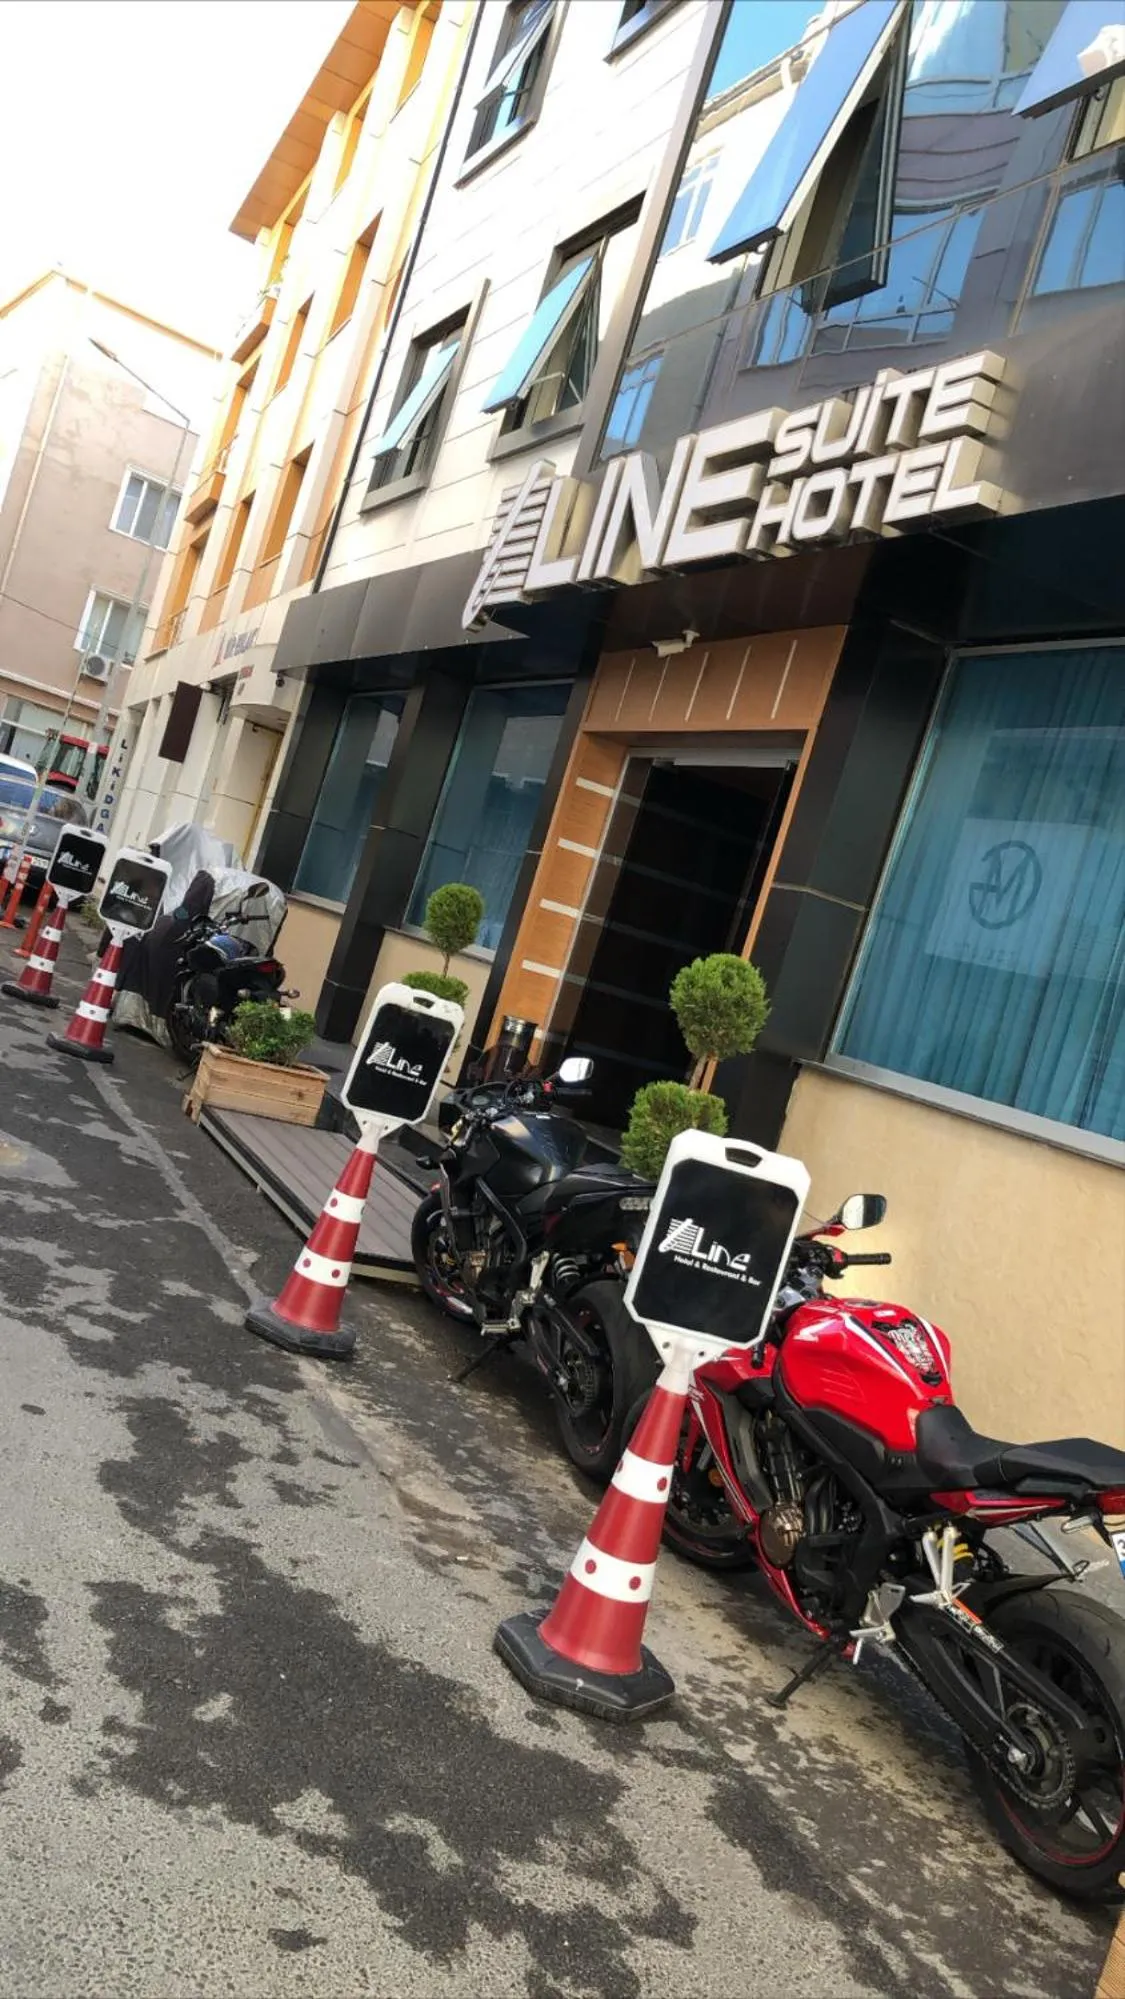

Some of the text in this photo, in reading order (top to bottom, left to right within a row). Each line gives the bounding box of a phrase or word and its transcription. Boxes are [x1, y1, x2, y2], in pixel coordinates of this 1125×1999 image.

[523, 407, 786, 592] LINE
[746, 436, 1002, 557] HOTEL
[691, 1226, 751, 1272] Line
